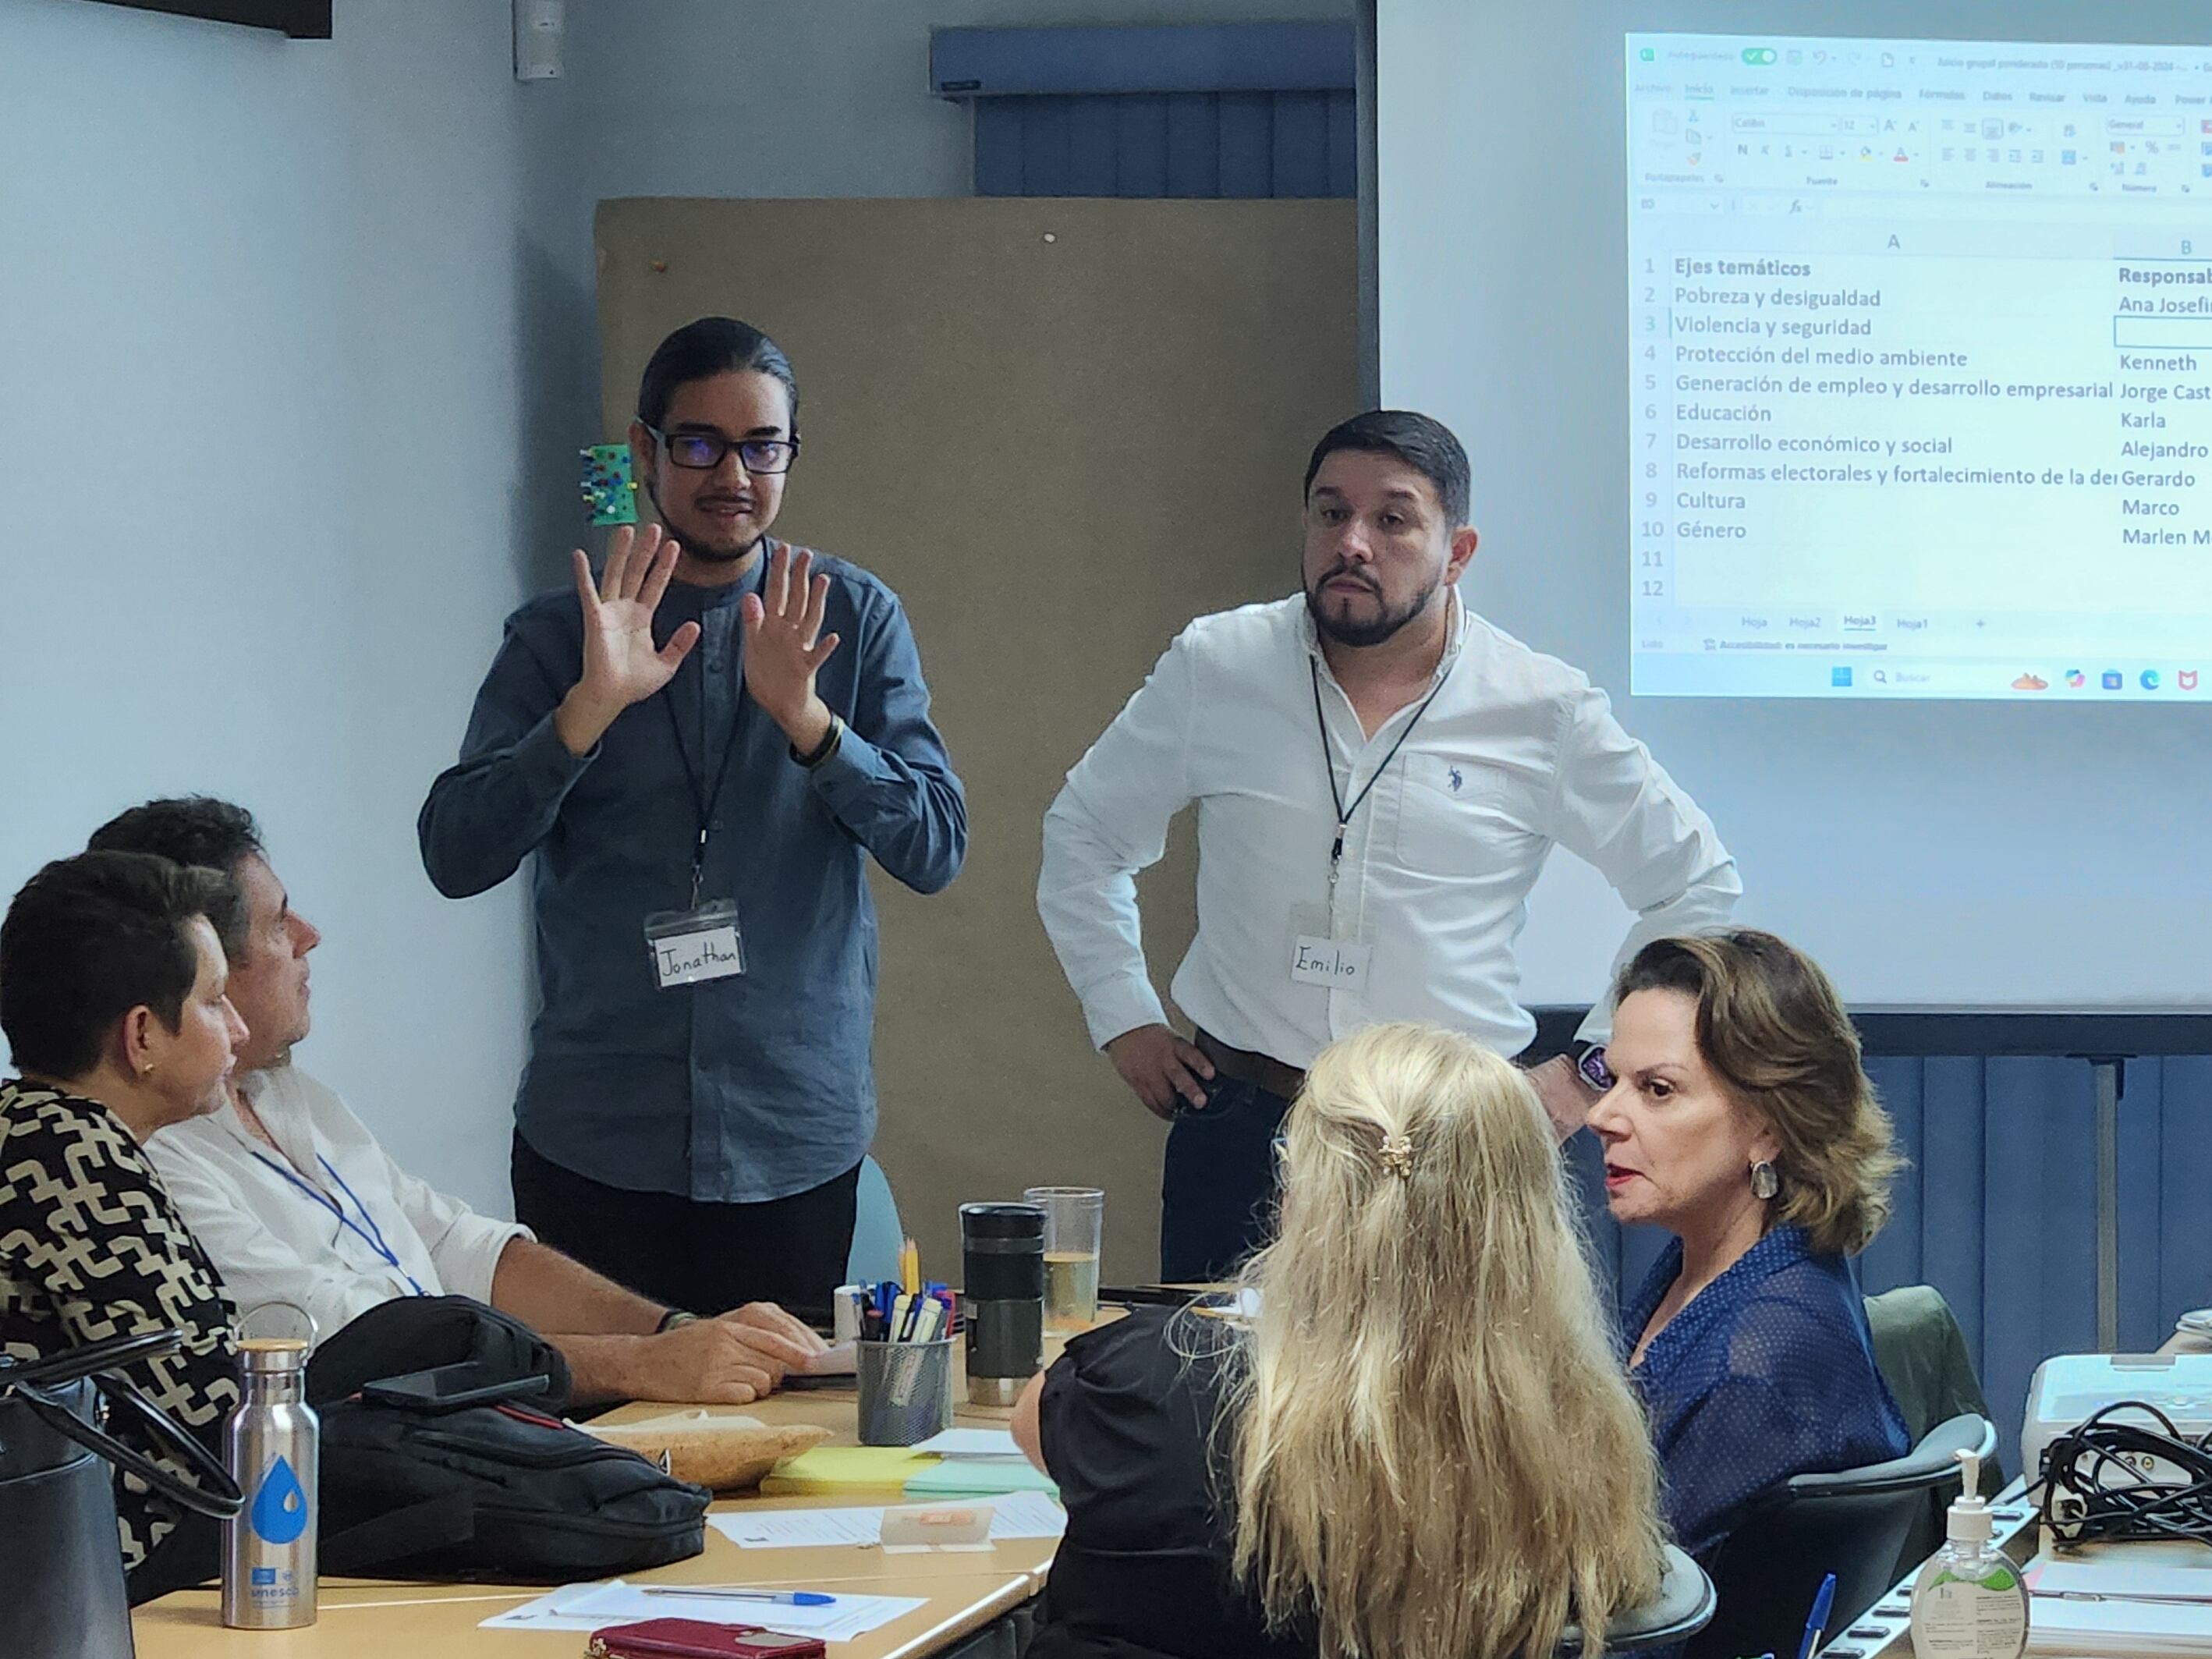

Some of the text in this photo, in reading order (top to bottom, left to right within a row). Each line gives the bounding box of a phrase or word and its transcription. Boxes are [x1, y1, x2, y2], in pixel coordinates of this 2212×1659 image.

[1888, 235, 1901, 249] A
[2181, 240, 2192, 255] B
[1646, 258, 1654, 273] 1
[1675, 257, 1811, 278] Ejes temáticos
[1645, 288, 1655, 303] 2
[1675, 287, 1881, 310] Pobreza y desigualdad
[2118, 296, 2212, 313] Ana Josefi
[1645, 317, 1655, 331] 3
[1675, 317, 1871, 339] Violencia y seguridad
[1645, 346, 1655, 360] 4
[1675, 346, 1968, 367] Protección del medio ambiente
[2120, 355, 2197, 370] Kenneth
[1645, 375, 1656, 390] 5
[1676, 374, 2113, 400] Generación de empleo y desarrollo empresarial
[2121, 383, 2212, 403] Jorge Cast
[1645, 404, 1657, 419] 6
[1676, 403, 1771, 421] Educación
[2121, 412, 2166, 428] Karla
[1646, 434, 1657, 449] 7
[1676, 434, 1952, 456] Desarrollo económico y social
[2121, 441, 2209, 462] Alejandro
[1646, 463, 1657, 478] 8
[1677, 462, 2118, 486] Reformas electorales y fortalecimiento de la de
[2122, 470, 2196, 487] Gerardo
[1646, 492, 1657, 508] 9
[1677, 491, 1746, 509] Cultura
[2122, 500, 2179, 516] Marco
[1642, 522, 1664, 537] 10
[1677, 520, 1746, 538] Género
[2123, 528, 2186, 545] Marlen
[1642, 551, 1663, 567] 11
[1642, 581, 1664, 596] 12
[1742, 617, 1768, 628] Hoja
[1844, 615, 1876, 626] Hoja3
[1897, 619, 1928, 630] Hoja1
[660, 942, 736, 977] Jonathan
[1296, 946, 1355, 975] Emilio
